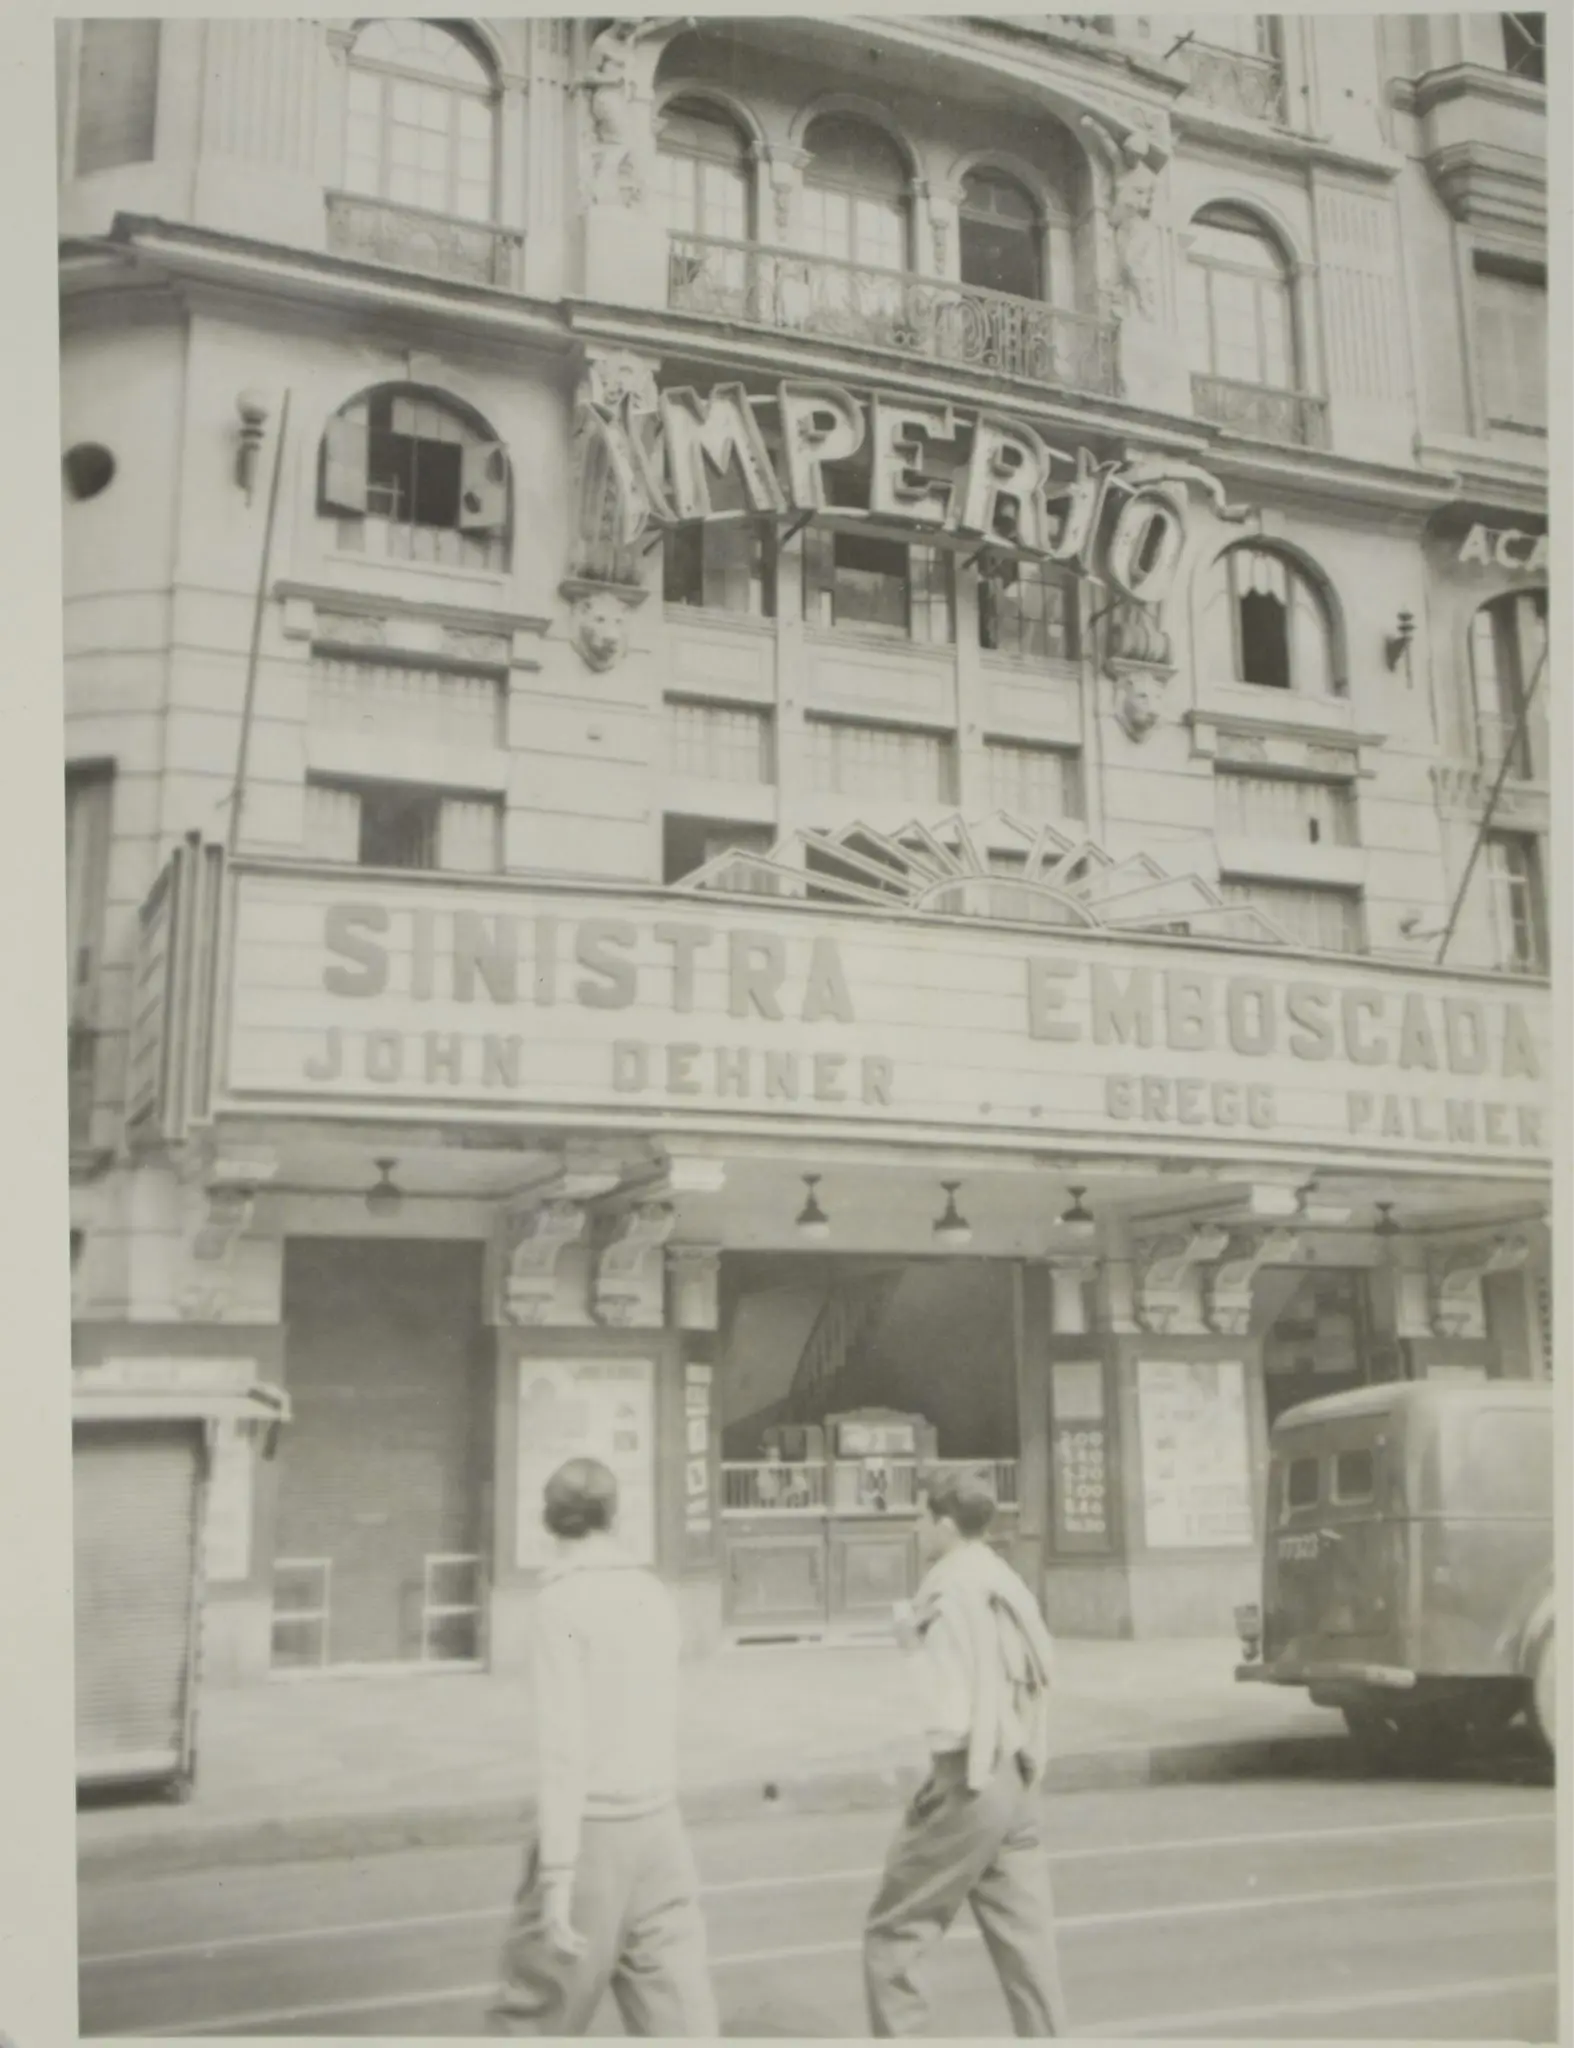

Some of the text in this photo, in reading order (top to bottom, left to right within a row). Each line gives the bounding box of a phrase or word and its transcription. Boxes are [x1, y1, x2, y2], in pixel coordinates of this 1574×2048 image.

[588, 379, 1186, 602] IMPERIO
[322, 901, 1542, 1080] SINISTRA EMBOSCADA
[303, 1027, 1546, 1149] JOHN DEHNER GREGG PALMER
